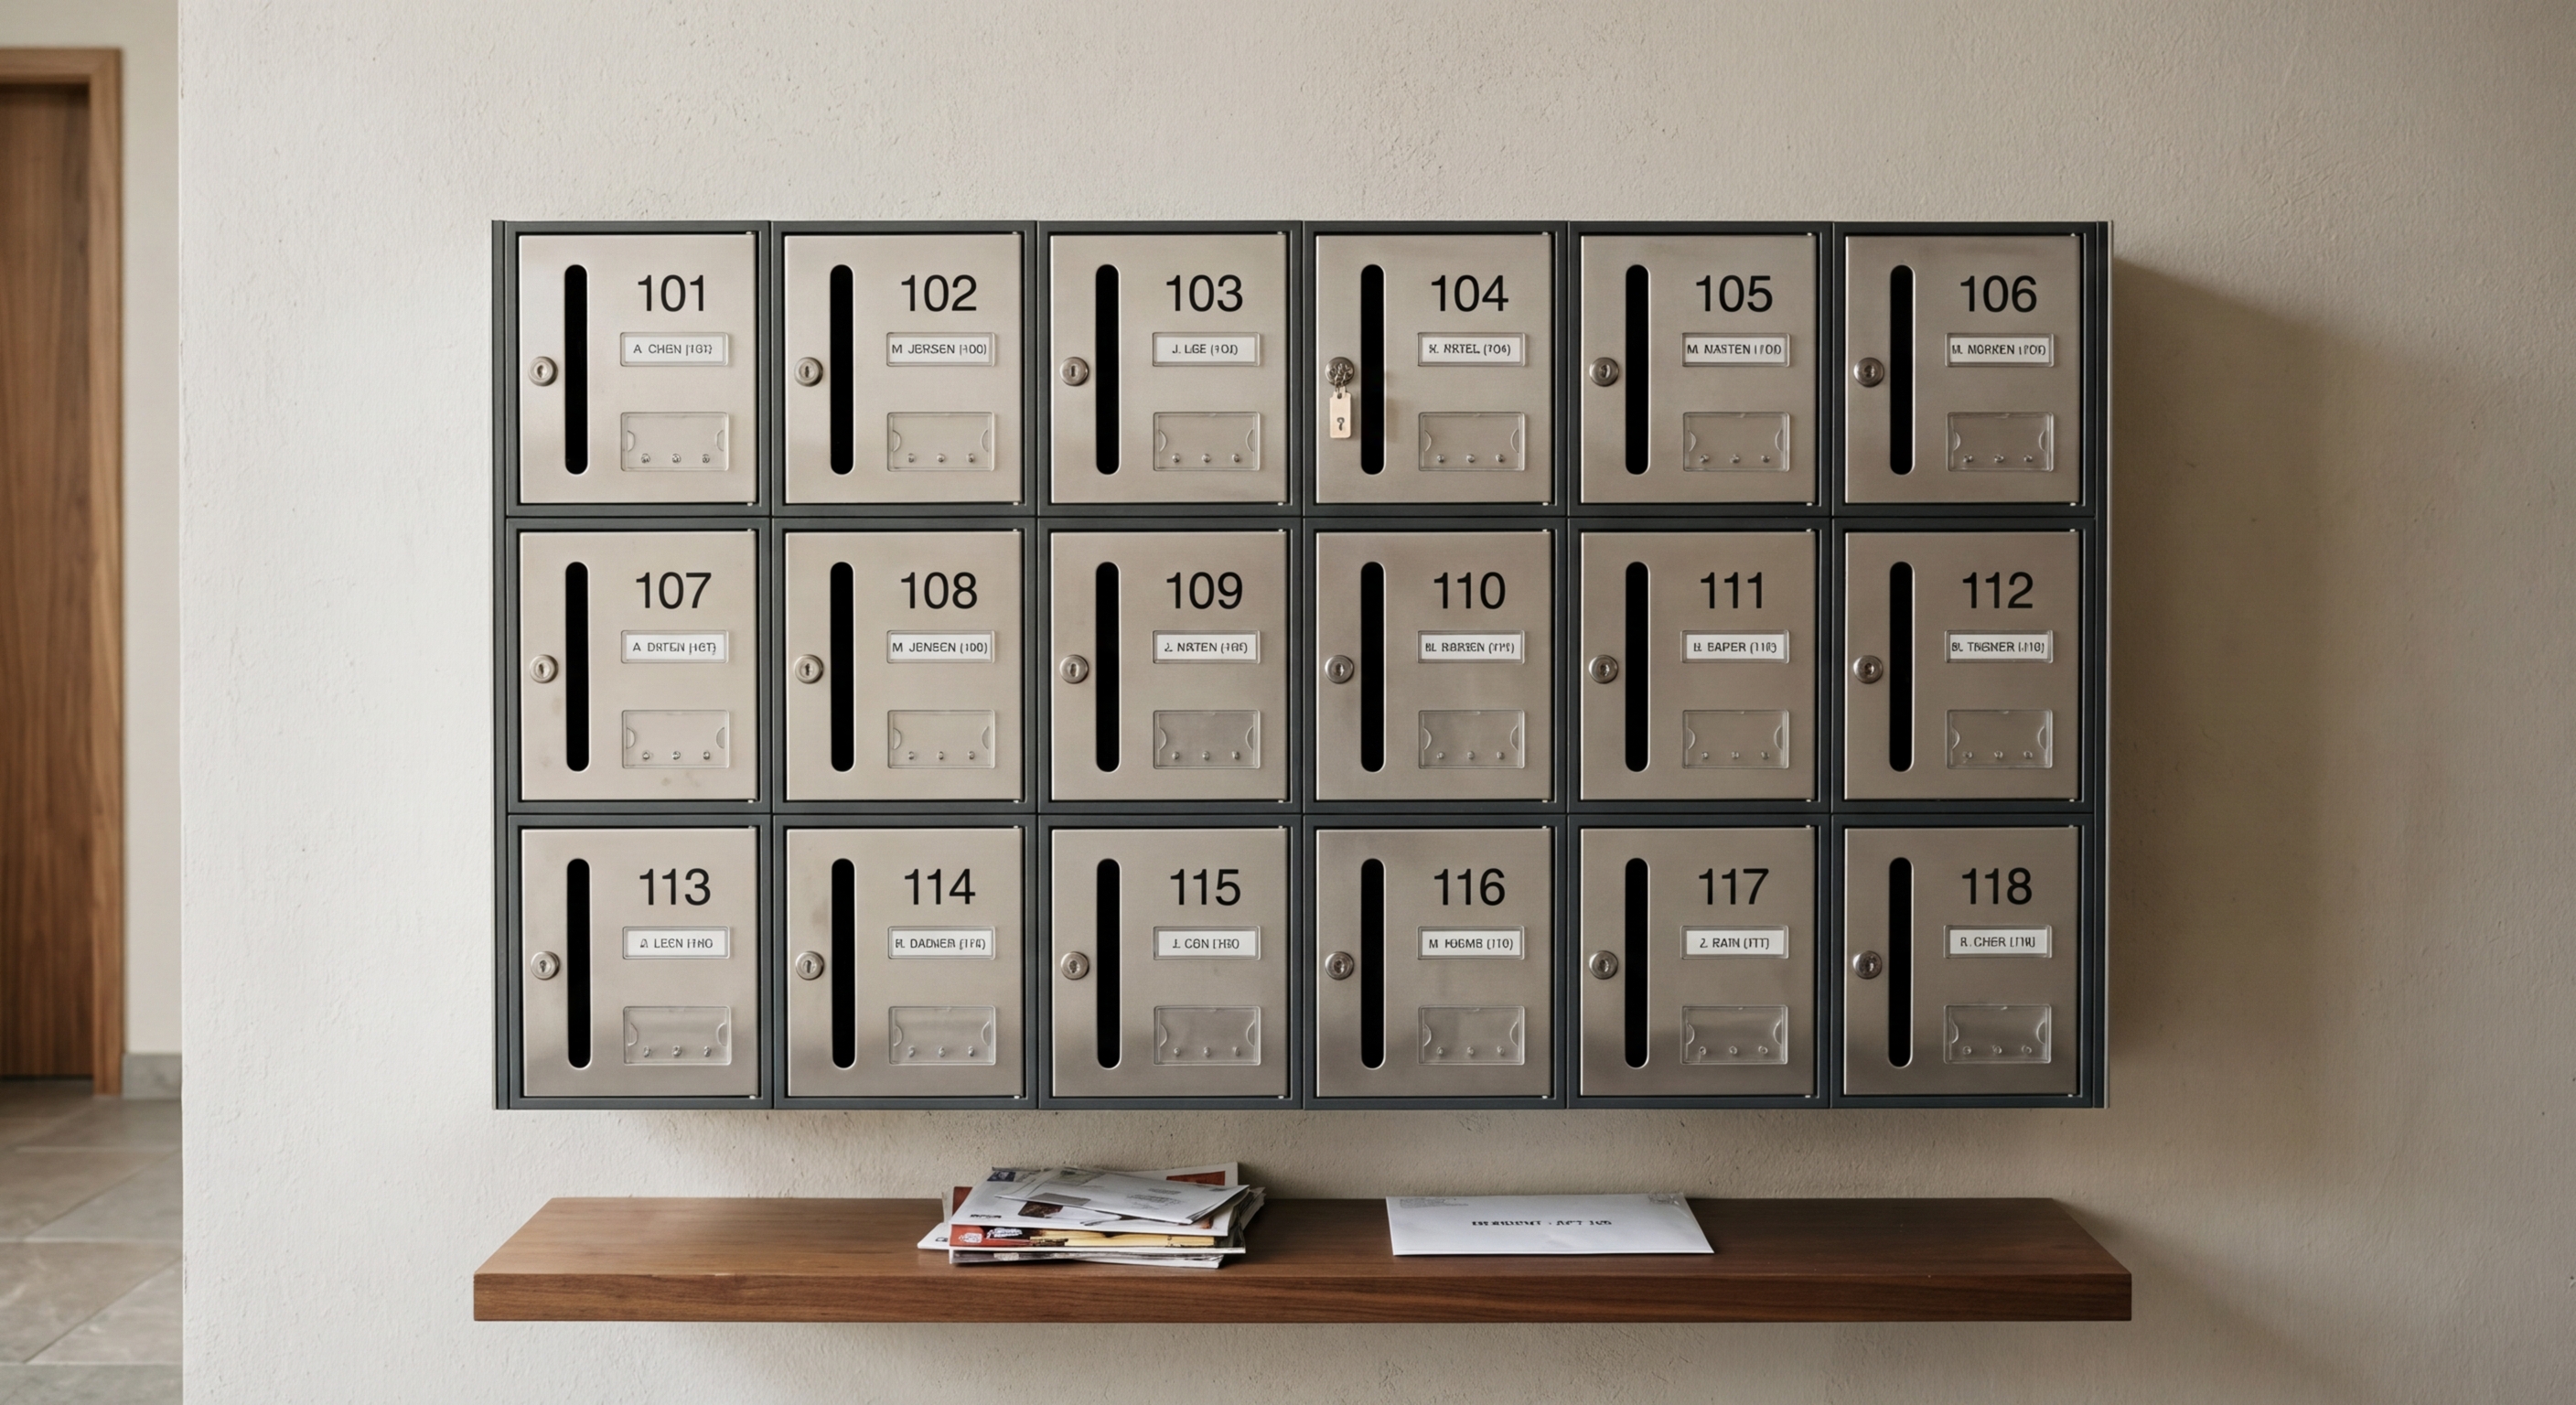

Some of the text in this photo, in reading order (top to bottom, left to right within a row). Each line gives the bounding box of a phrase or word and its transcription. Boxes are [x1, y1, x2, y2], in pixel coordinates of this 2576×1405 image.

[638, 274, 703, 312] 101
[901, 274, 977, 312] 102
[1166, 274, 1243, 313] 103
[1431, 274, 1509, 313] 104
[1695, 274, 1773, 313] 105
[1959, 274, 2037, 314] 106
[648, 344, 683, 354] CHEN
[636, 572, 712, 609] 107
[900, 572, 978, 610] 108
[1166, 571, 1243, 610] 109
[1433, 571, 1506, 610] 110
[1700, 571, 1763, 610] 111
[1961, 571, 2034, 610] 112
[639, 868, 711, 906] 113
[904, 868, 976, 906] 114
[1170, 868, 1241, 906] 115
[1433, 867, 1506, 906] 116
[1698, 867, 1770, 906] 117
[1961, 866, 2034, 906] 118
